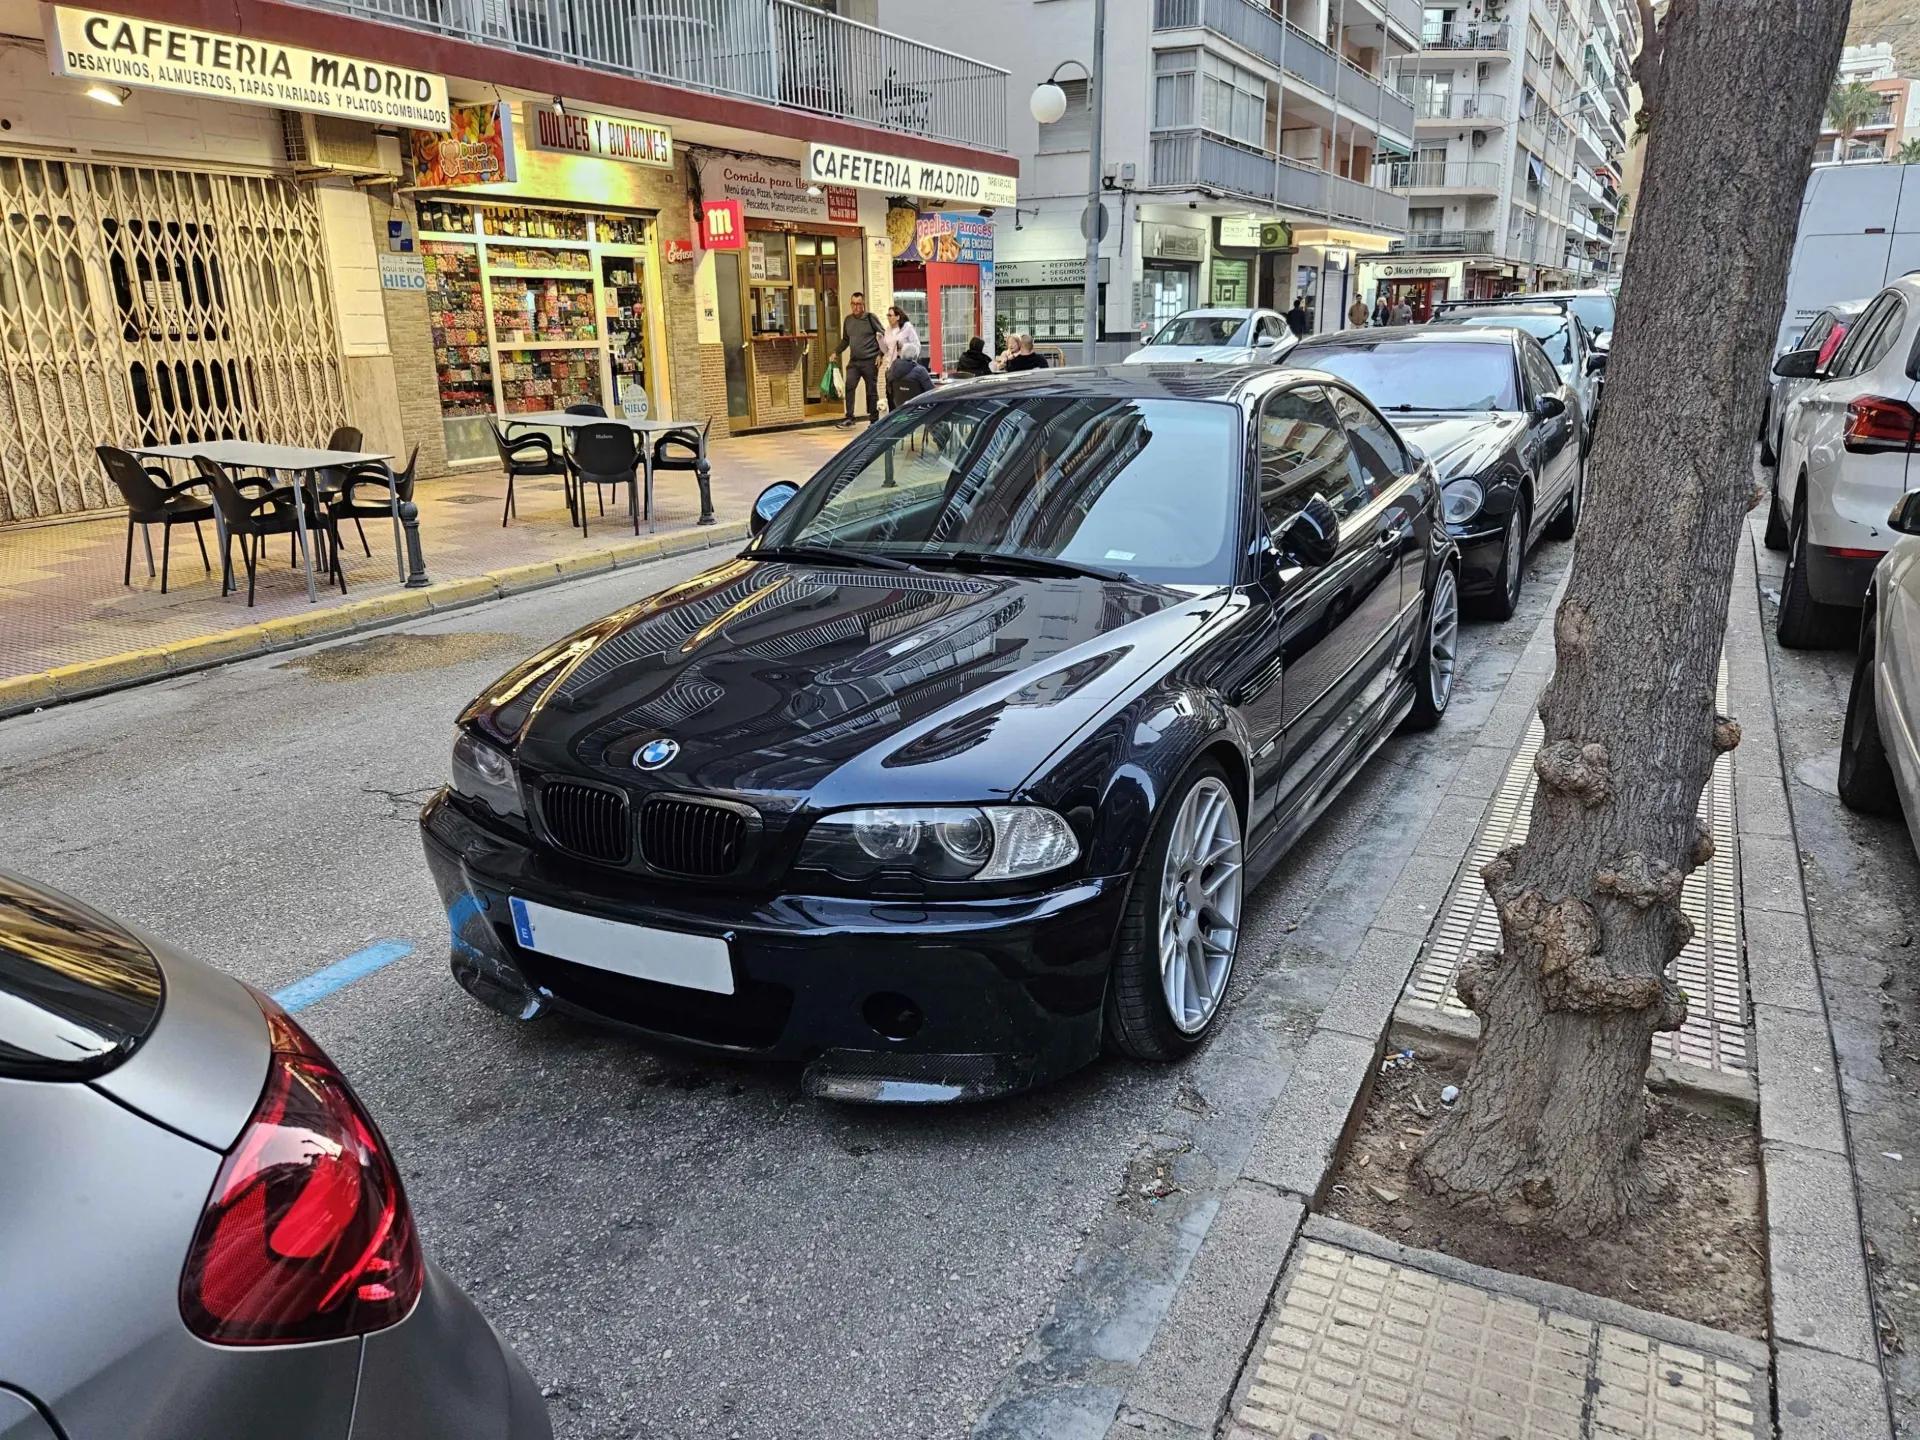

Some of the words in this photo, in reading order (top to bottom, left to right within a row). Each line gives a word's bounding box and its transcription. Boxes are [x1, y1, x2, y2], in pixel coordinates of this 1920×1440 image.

[84, 17, 292, 80] CAFETERIA
[311, 56, 432, 102] MADRID
[68, 51, 155, 82] DESAYUNOS,
[158, 65, 237, 94] ALMUERZOS,
[238, 78, 274, 97] TAPAS
[277, 84, 330, 106] VARIADAS
[336, 94, 343, 108] Y
[346, 95, 383, 114] PLATOS
[386, 101, 447, 124] COMBINADOS
[538, 110, 590, 151] DULCES
[595, 120, 602, 154] Y
[460, 141, 488, 159] Dulce
[459, 156, 499, 173] Elefante
[812, 149, 911, 190] CAFETERIA
[918, 166, 980, 198] MADRID
[723, 168, 767, 184] Comida
[769, 177, 794, 190] para
[916, 213, 952, 241] paellas
[958, 221, 994, 239] arroces
[383, 273, 425, 289] HIELO
[624, 403, 648, 413] HIELO
[521, 927, 529, 939] E
